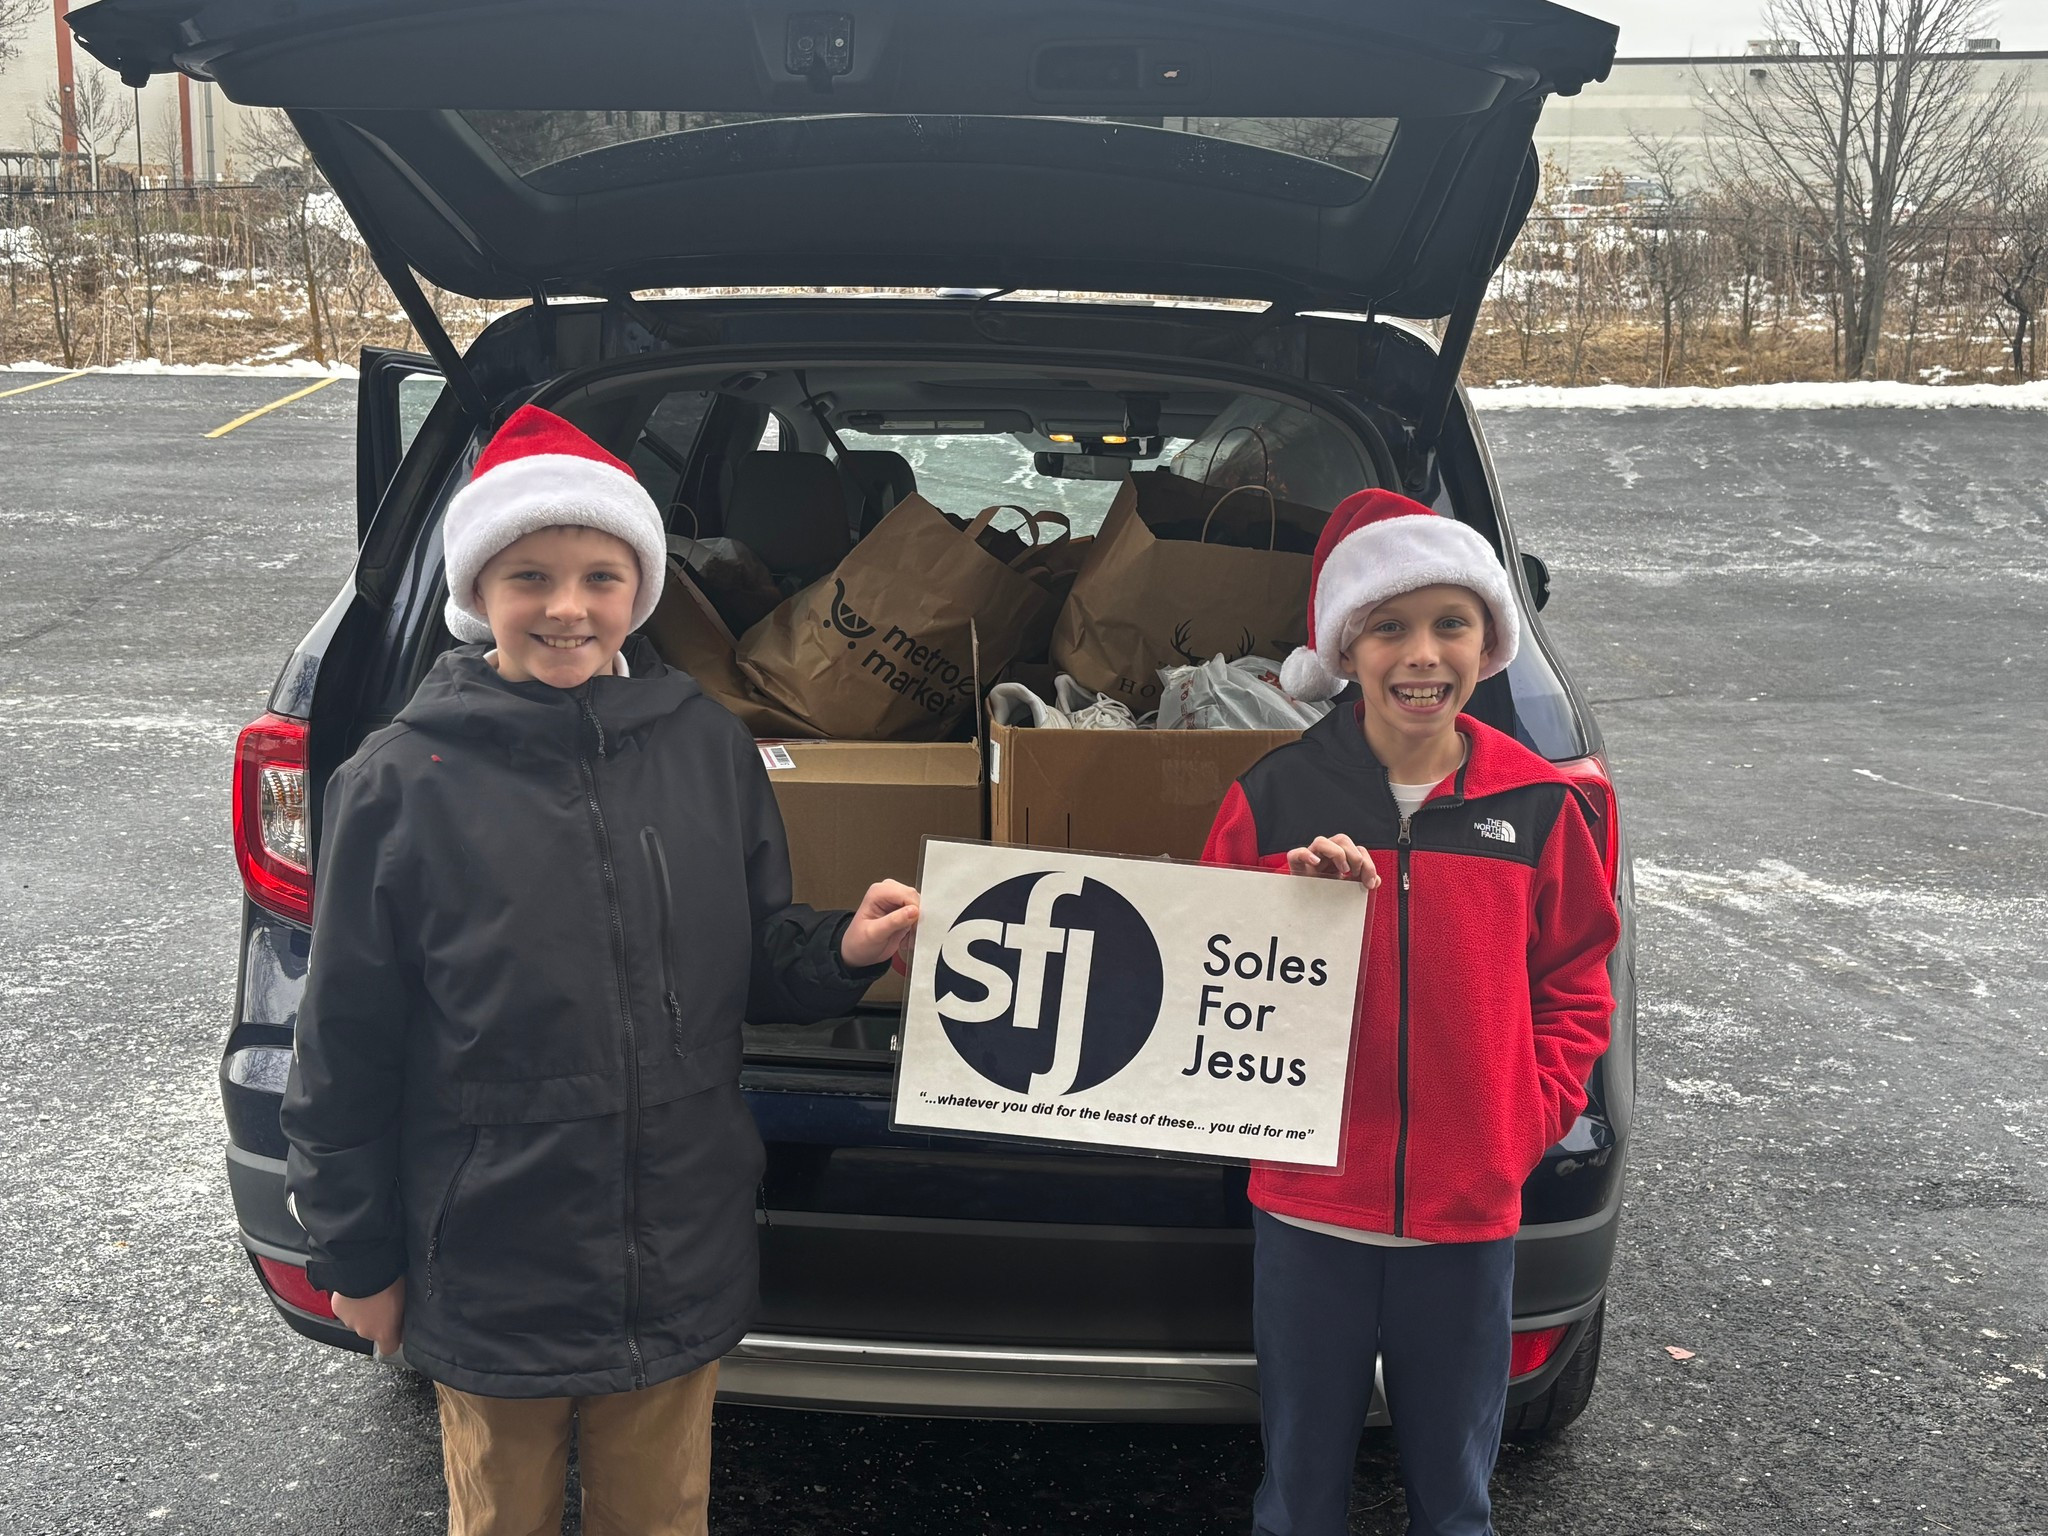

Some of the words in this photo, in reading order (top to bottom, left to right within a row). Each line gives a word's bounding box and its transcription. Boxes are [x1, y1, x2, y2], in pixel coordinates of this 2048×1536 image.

[882, 625, 960, 684] metro
[861, 649, 956, 716] market
[1473, 822, 1501, 834] NORTH
[1480, 830, 1501, 840] FACE
[1486, 817, 1502, 827] THE
[935, 871, 1095, 1096] sfj
[1203, 933, 1328, 987] Soles
[1198, 985, 1276, 1032] For
[1181, 1034, 1307, 1087] Jesus
[1001, 1101, 1028, 1114] you
[1031, 1102, 1055, 1115] did
[1056, 1105, 1077, 1118] for
[1079, 1107, 1101, 1120] the
[1103, 1109, 1138, 1124] least
[1140, 1113, 1157, 1126] of
[1157, 1115, 1205, 1130] these...
[1208, 1122, 1235, 1135] you
[1238, 1123, 1262, 1136] did
[1263, 1125, 1284, 1138] for
